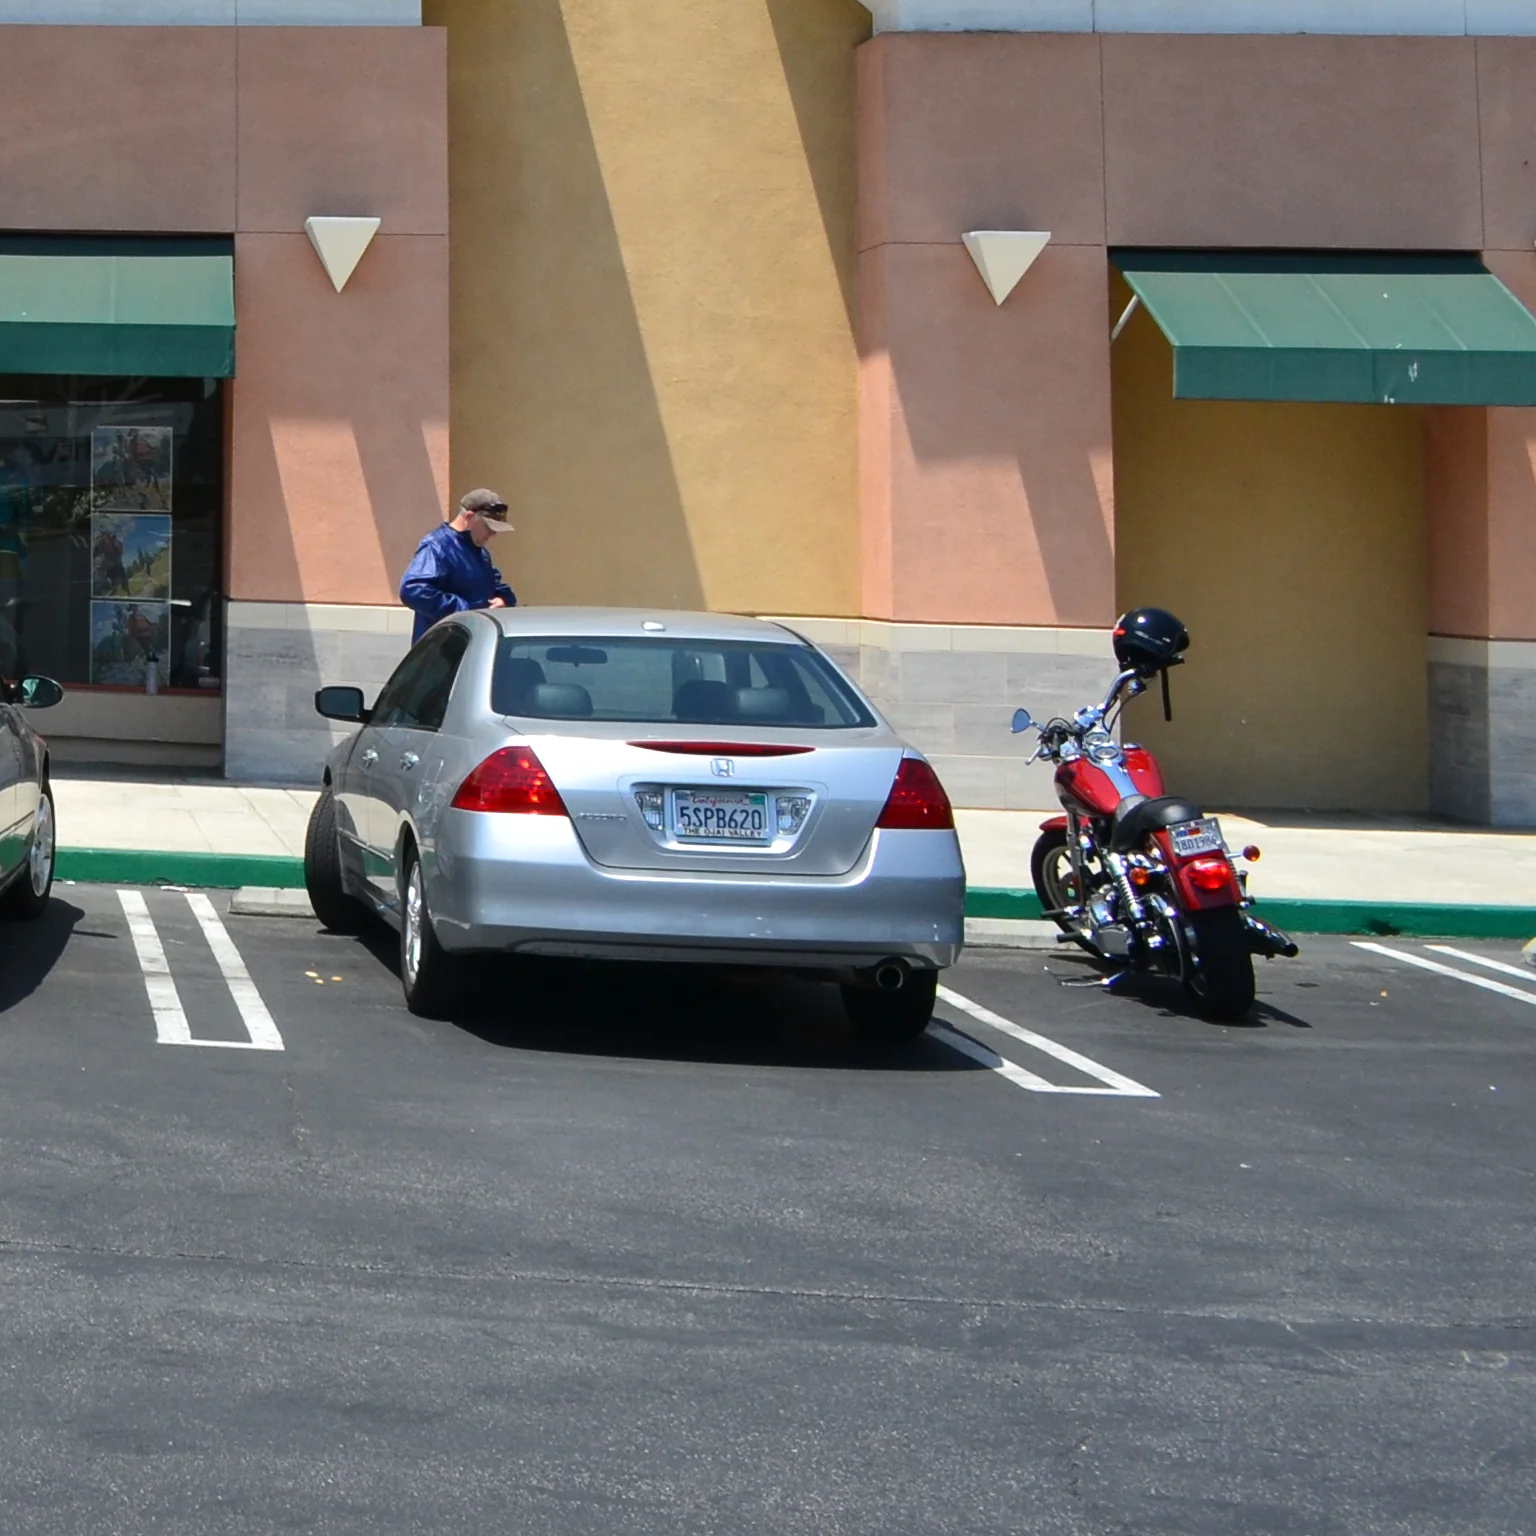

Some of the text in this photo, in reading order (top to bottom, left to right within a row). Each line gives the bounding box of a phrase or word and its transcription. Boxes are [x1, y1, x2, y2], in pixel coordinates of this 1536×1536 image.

[680, 805, 763, 830] 5SPB620
[683, 827, 701, 835] THE
[728, 829, 762, 837] VALLEY
